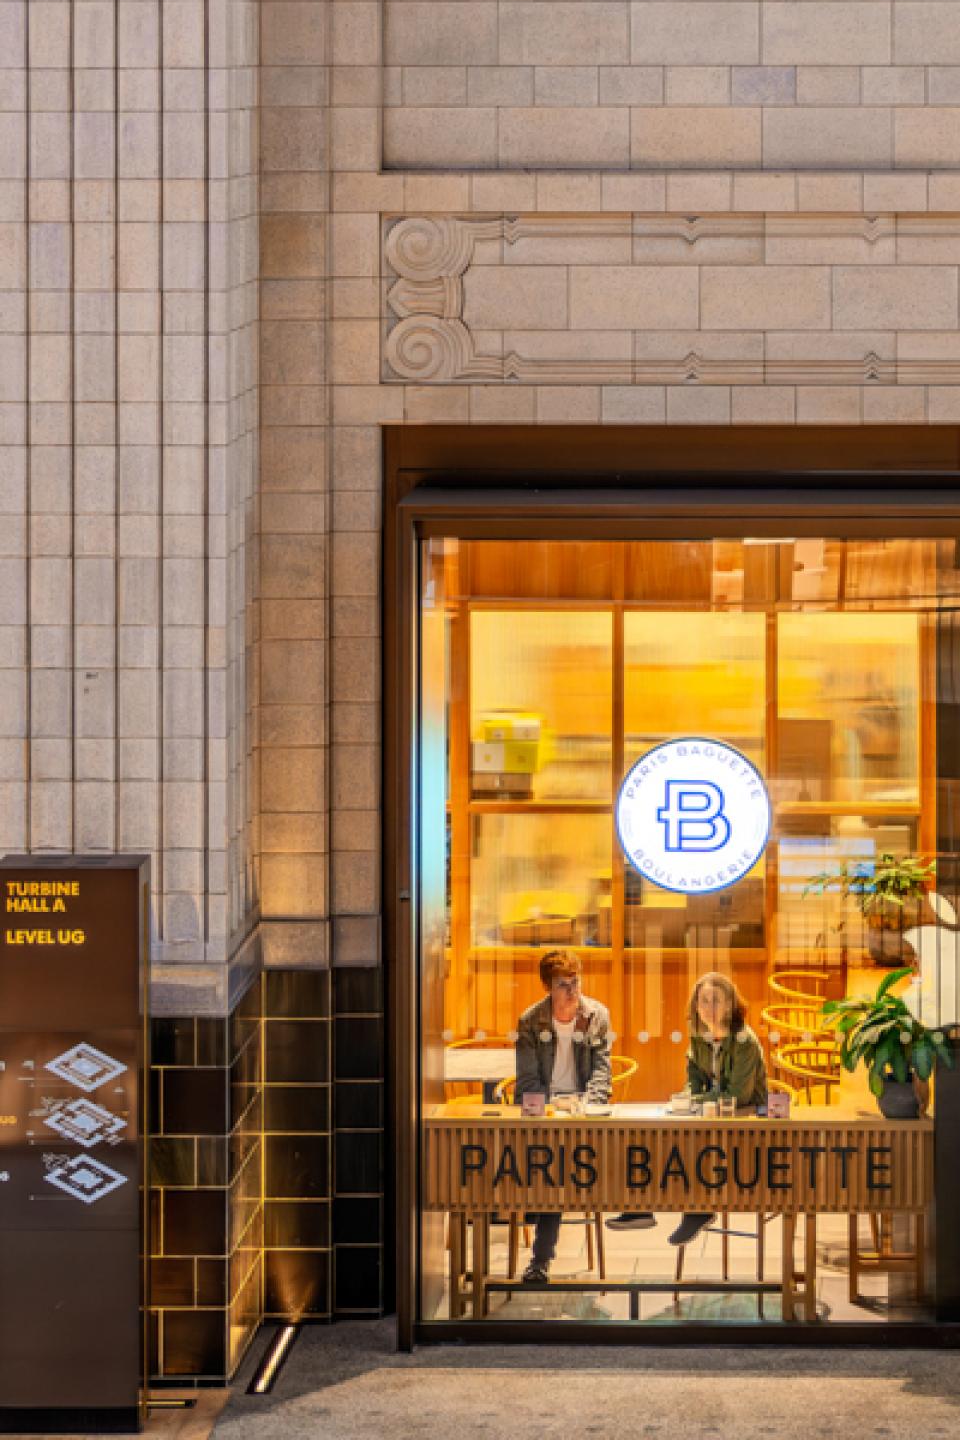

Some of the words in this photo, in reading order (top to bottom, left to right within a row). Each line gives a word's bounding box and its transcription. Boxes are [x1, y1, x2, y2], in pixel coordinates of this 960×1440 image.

[626, 753, 668, 799] PARIS
[676, 746, 762, 799] BAGUETTE
[633, 849, 753, 886] BOULANGERIE
[6, 882, 80, 896] TURBINE
[6, 898, 49, 913] HALL
[52, 898, 67, 913] A
[6, 930, 56, 944] LEVEL
[57, 930, 86, 944] UG
[460, 1145, 598, 1189] PARIS
[625, 1145, 893, 1190] BAGUETTE
